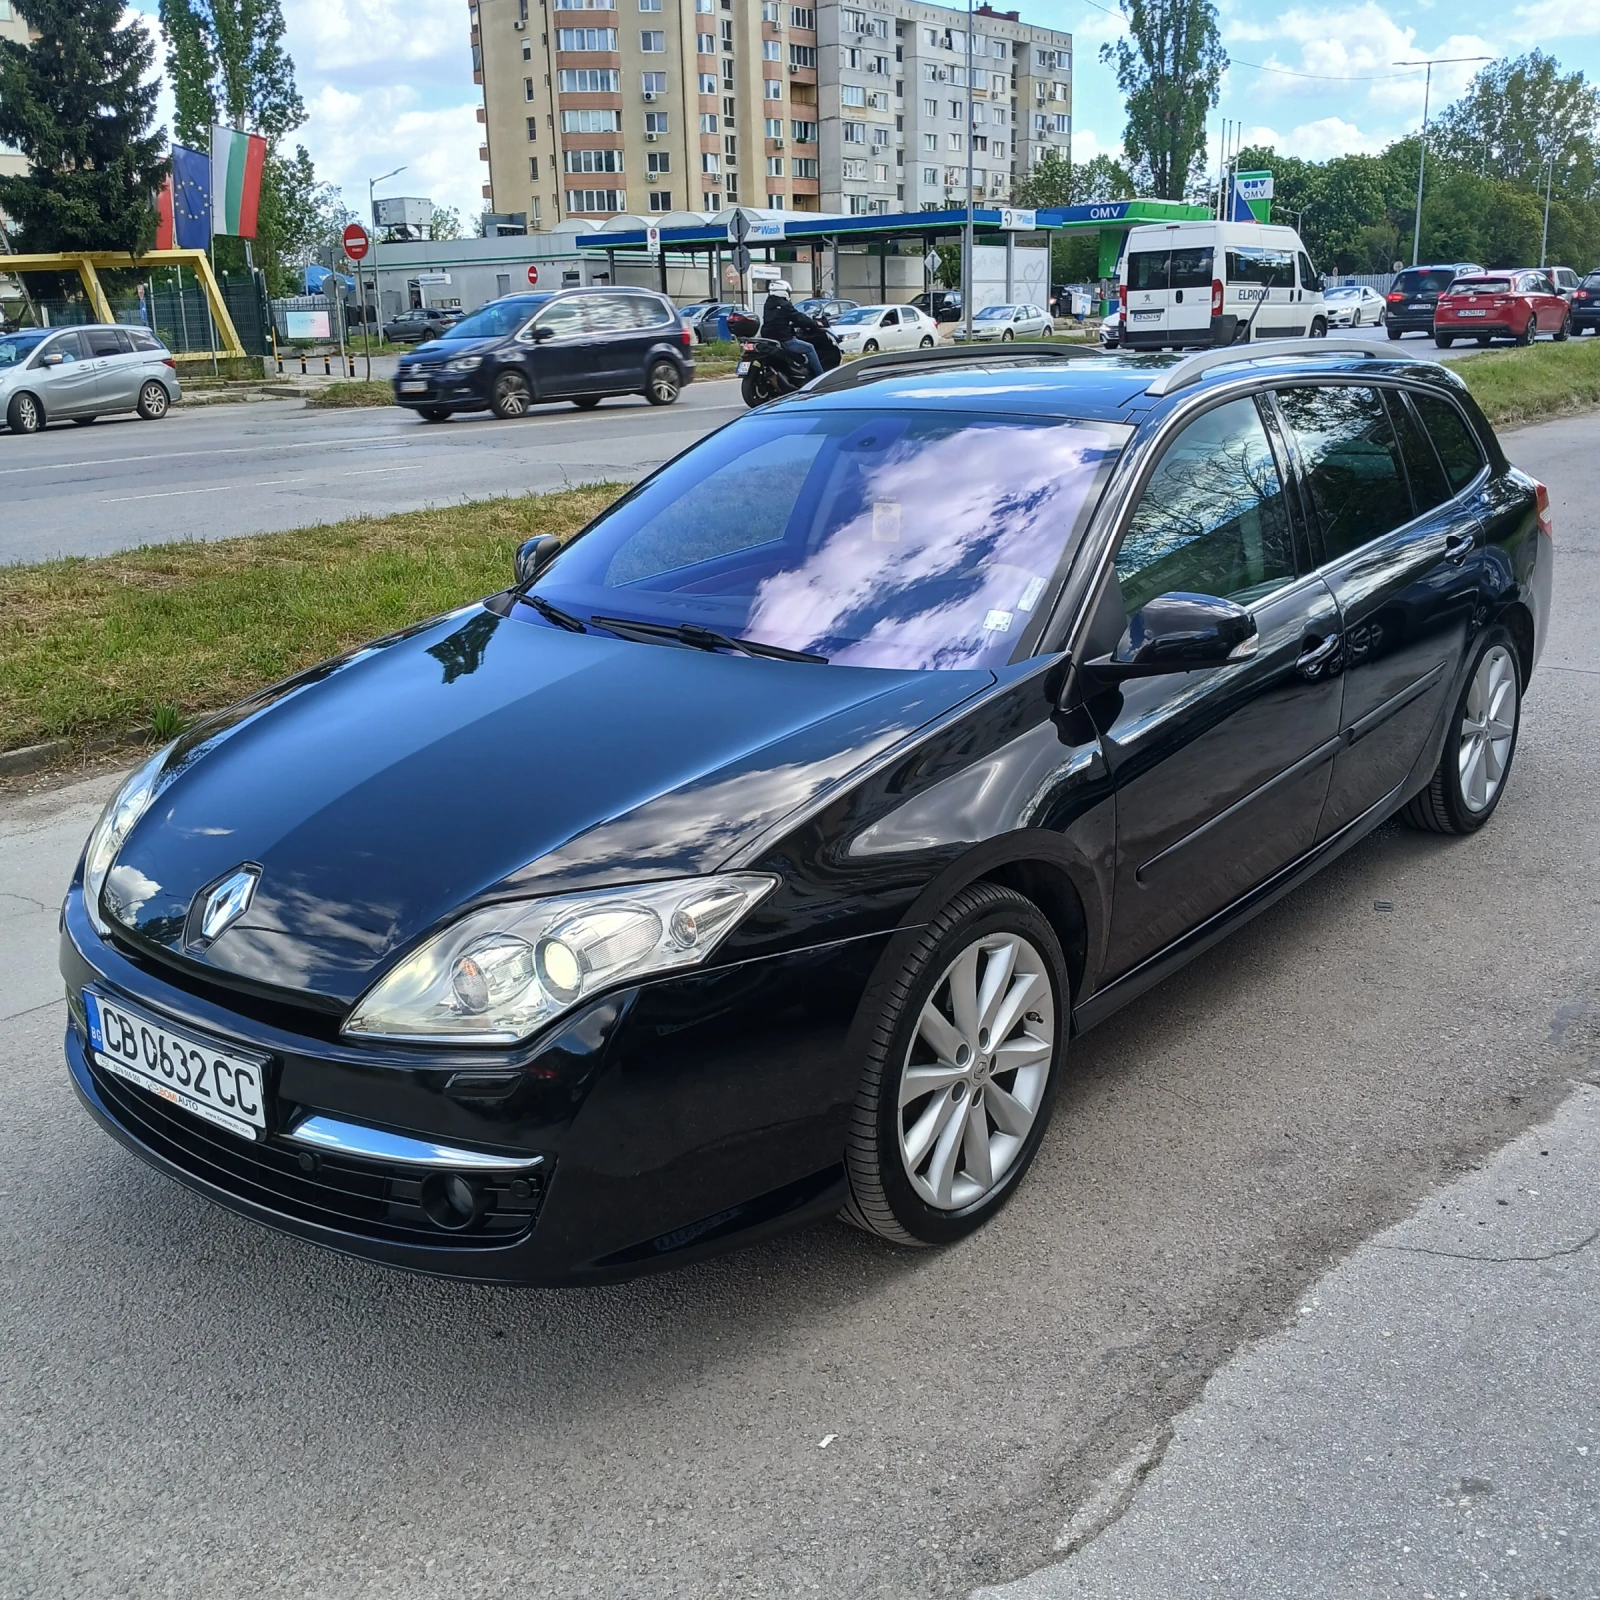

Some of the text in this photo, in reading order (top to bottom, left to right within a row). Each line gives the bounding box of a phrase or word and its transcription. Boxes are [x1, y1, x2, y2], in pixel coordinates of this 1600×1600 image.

[1243, 190, 1266, 199] OMV
[1090, 206, 1120, 219] OMV
[91, 1026, 101, 1042] BG
[178, 1097, 198, 1111] AUTO
